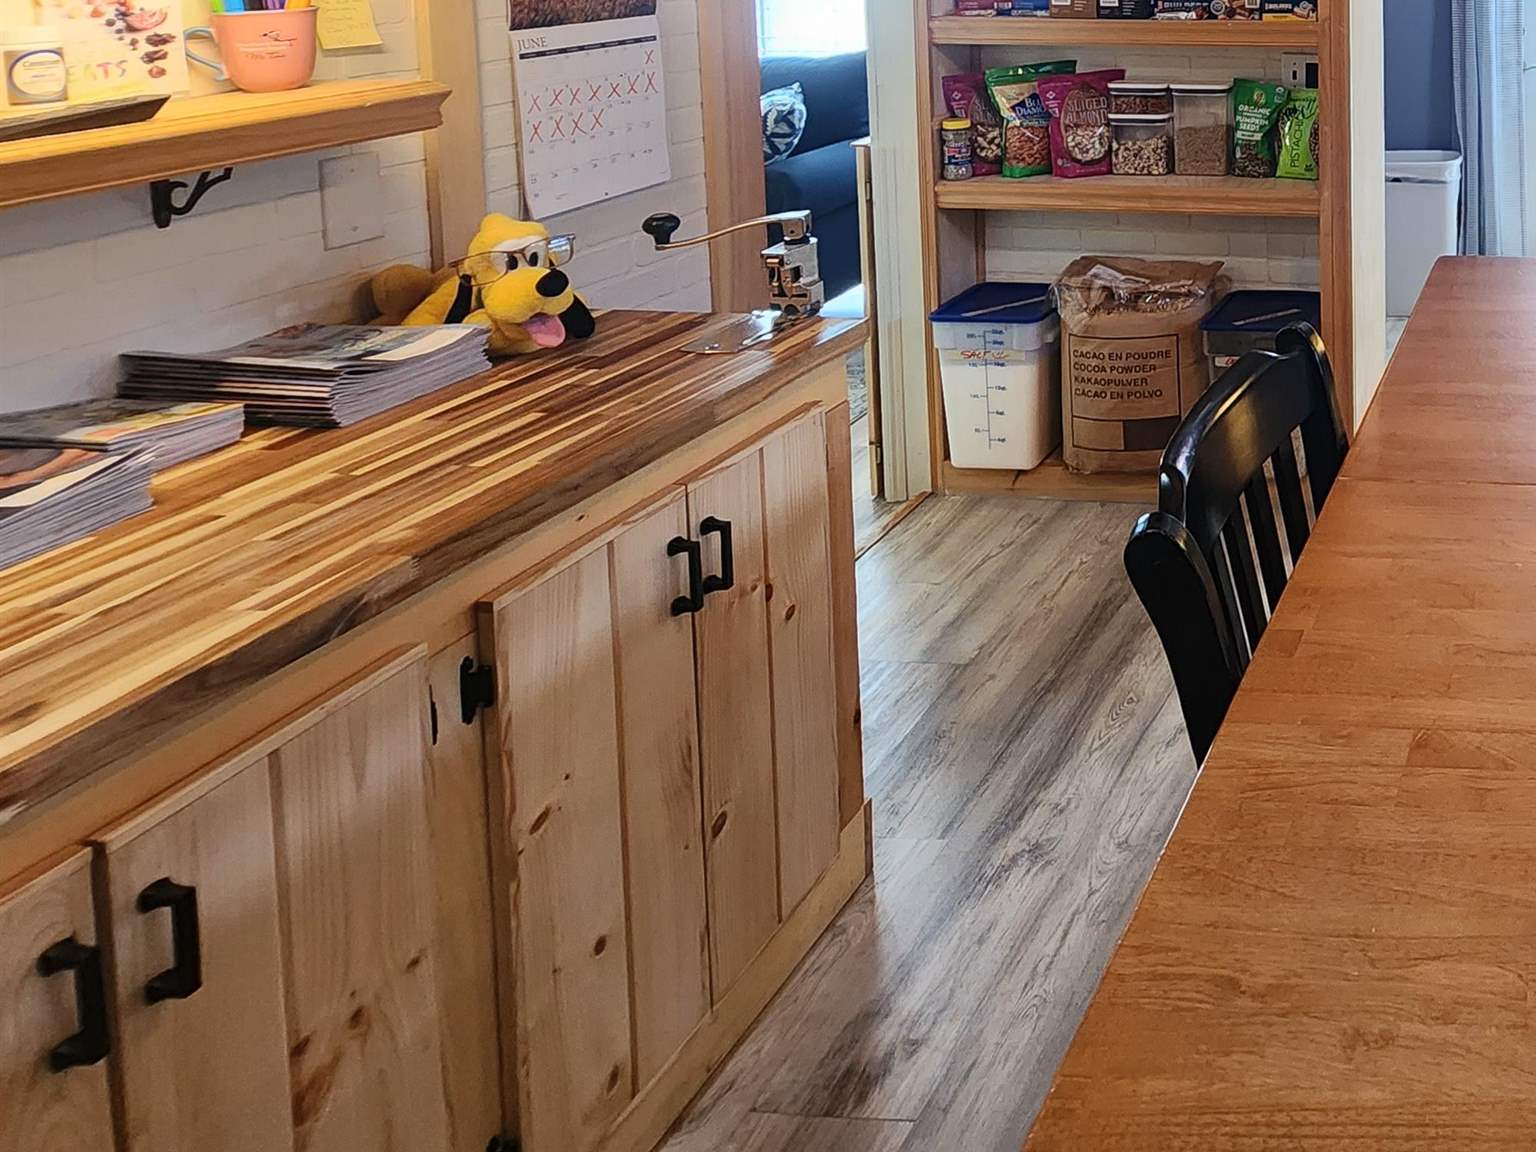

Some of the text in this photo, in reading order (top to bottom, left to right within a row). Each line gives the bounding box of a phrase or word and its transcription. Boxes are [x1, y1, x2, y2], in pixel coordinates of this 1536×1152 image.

[517, 36, 548, 52] JUNE
[1067, 97, 1108, 111] SLICED
[1238, 104, 1271, 115] ORGANIC
[1066, 109, 1108, 124] ALMOND
[1235, 114, 1269, 126] PUMPKIN
[1239, 122, 1260, 131] SEEDS
[1073, 349, 1173, 361] CACAO EN POUDRE
[1073, 362, 1157, 375] COCOA POWDER
[1073, 375, 1149, 387] KAKAOPULVER
[1074, 388, 1163, 400] CACAO EN POLVO
